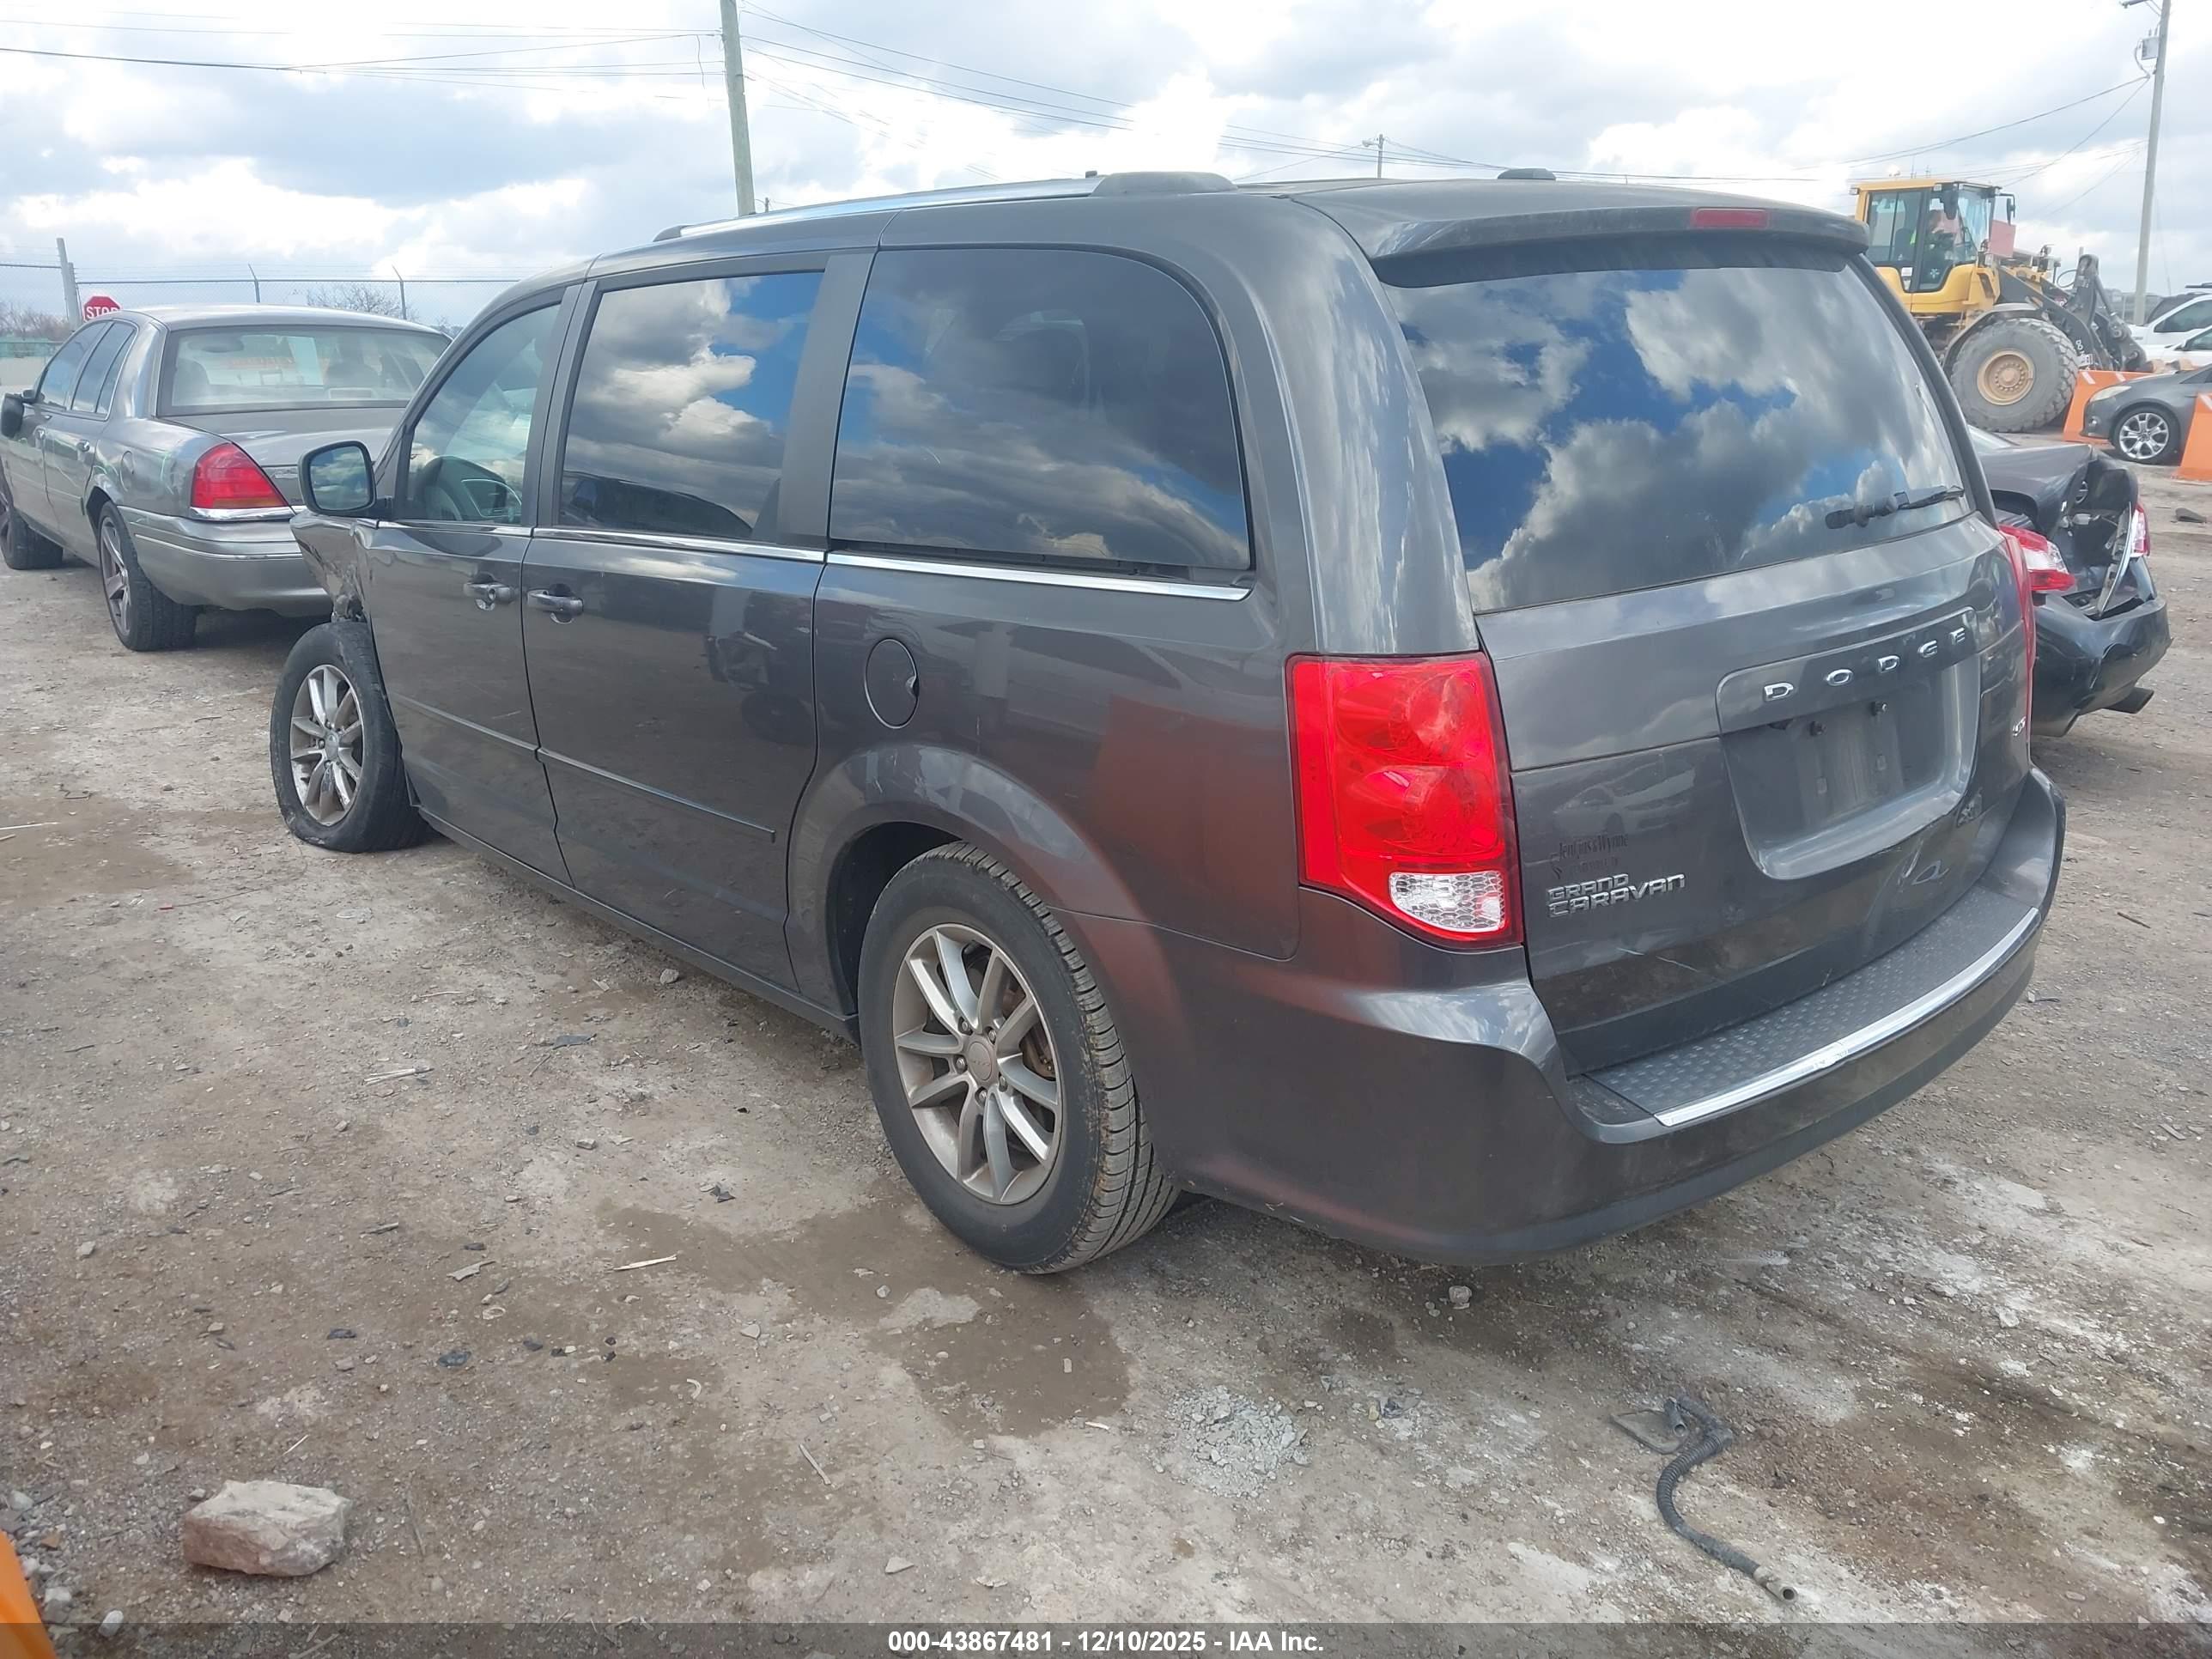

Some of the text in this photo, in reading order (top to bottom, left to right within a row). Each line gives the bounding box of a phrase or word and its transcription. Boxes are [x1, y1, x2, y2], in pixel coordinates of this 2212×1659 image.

[1763, 627, 1966, 701] DODGE
[1547, 873, 1629, 900] GRAND
[1547, 873, 1686, 918] CARAVAN
